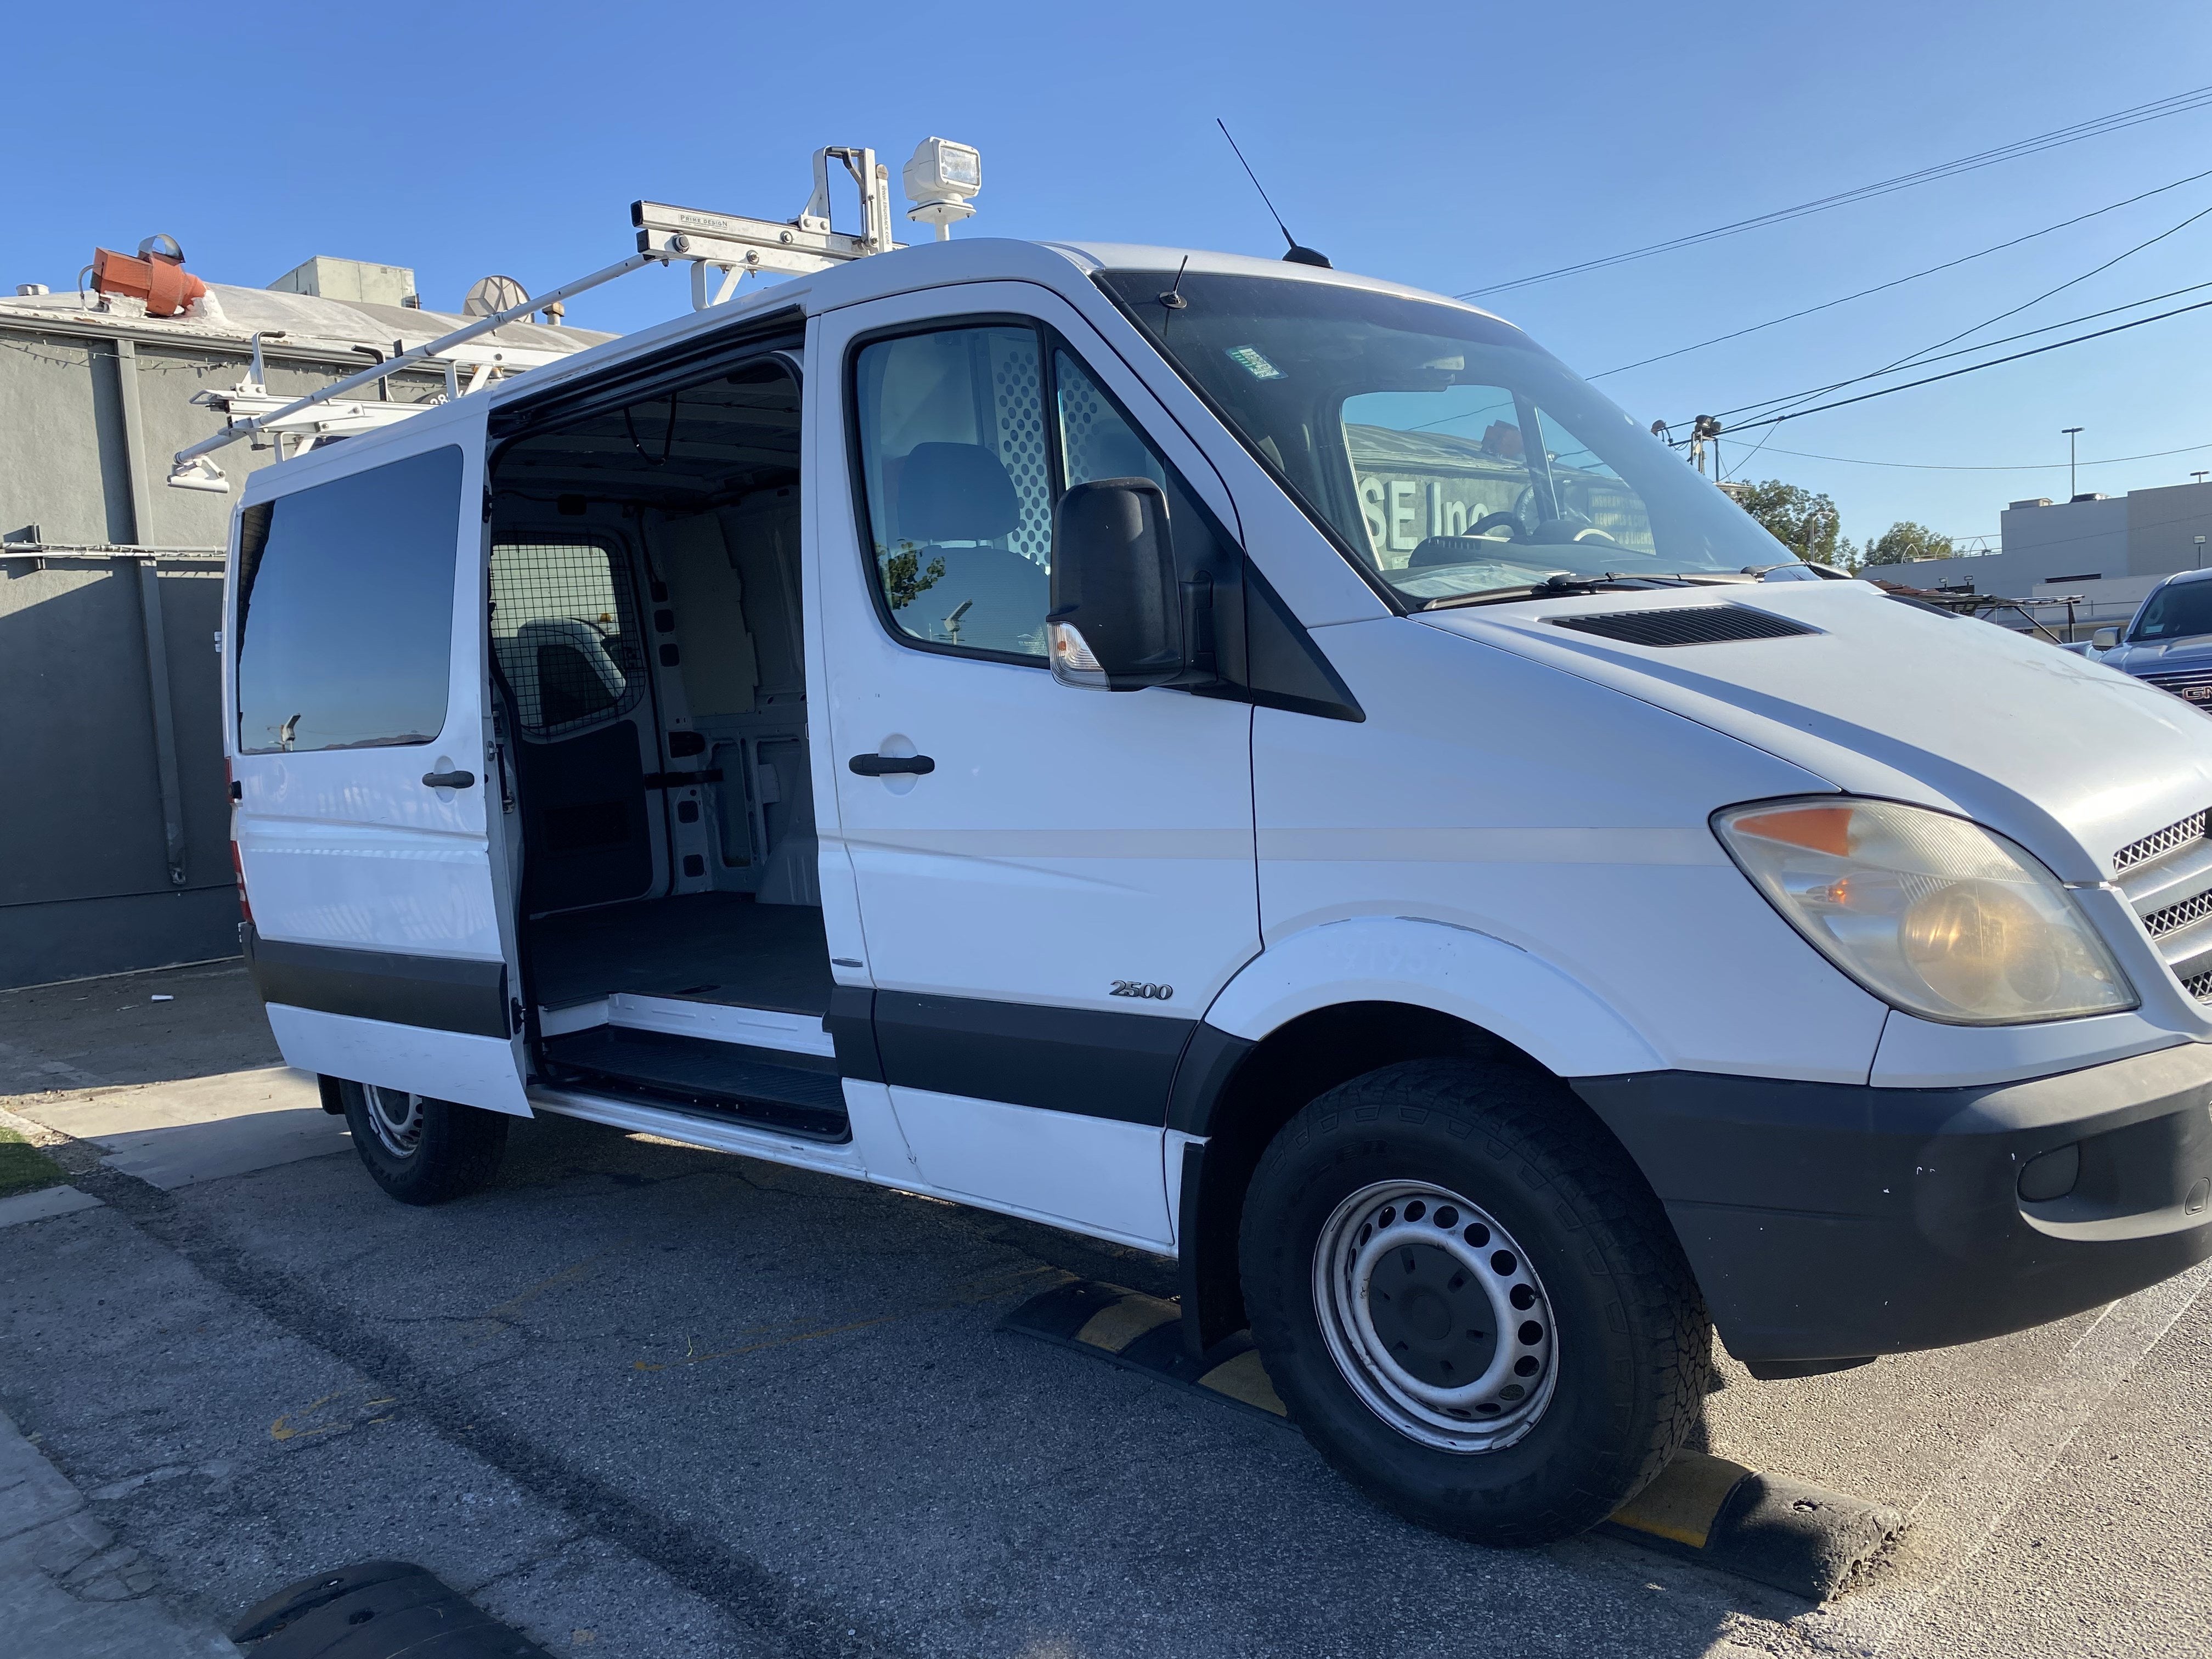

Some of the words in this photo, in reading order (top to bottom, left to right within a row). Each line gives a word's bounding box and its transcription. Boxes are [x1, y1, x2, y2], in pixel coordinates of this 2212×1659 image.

[680, 215, 701, 223] PRIME
[1595, 512, 1627, 527] REQUIRES
[1109, 980, 1173, 1000] 2500
